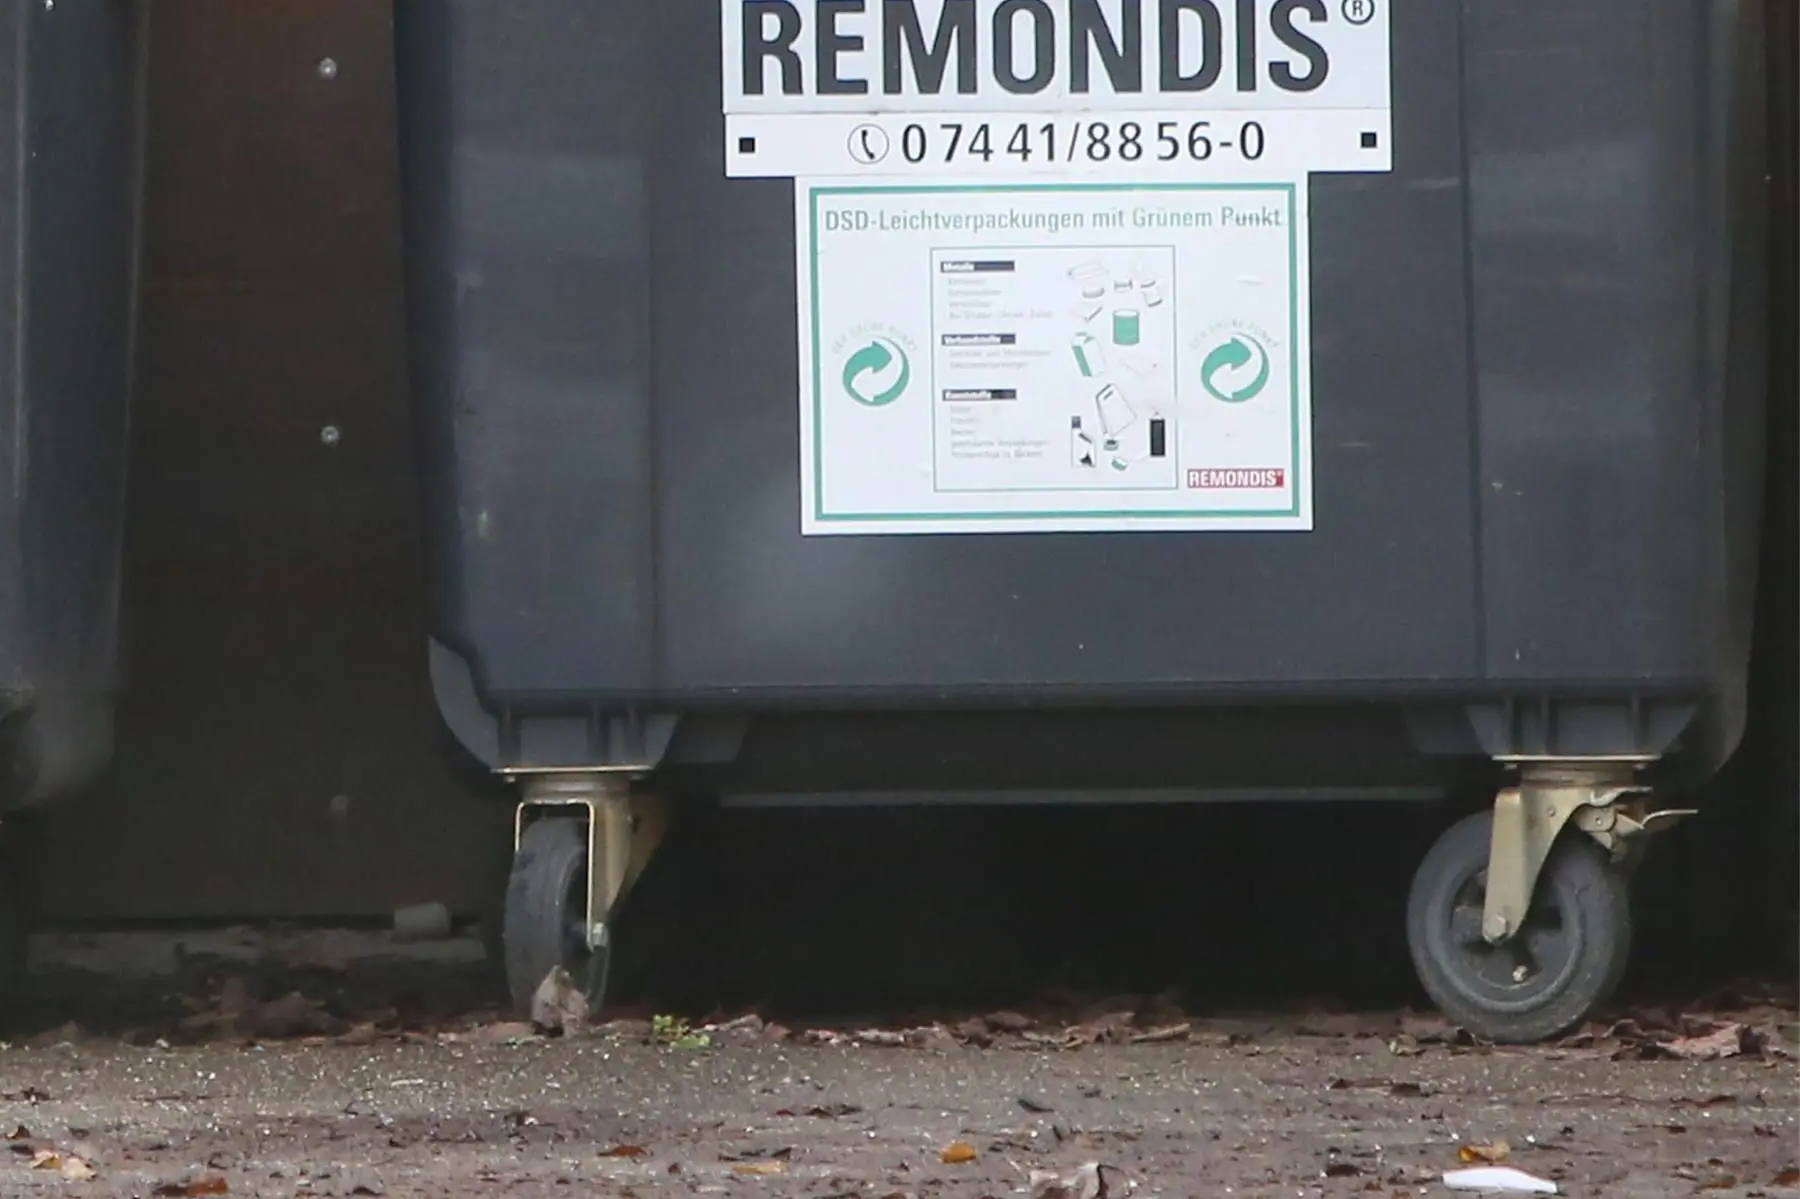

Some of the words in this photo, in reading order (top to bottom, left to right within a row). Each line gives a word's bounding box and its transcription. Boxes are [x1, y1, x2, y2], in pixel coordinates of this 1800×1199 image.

[825, 208, 1085, 233] DSD-Leichtverpackungen
[1091, 207, 1124, 228] mit
[1132, 206, 1213, 228] Grünem
[1221, 205, 1282, 227] Punkt
